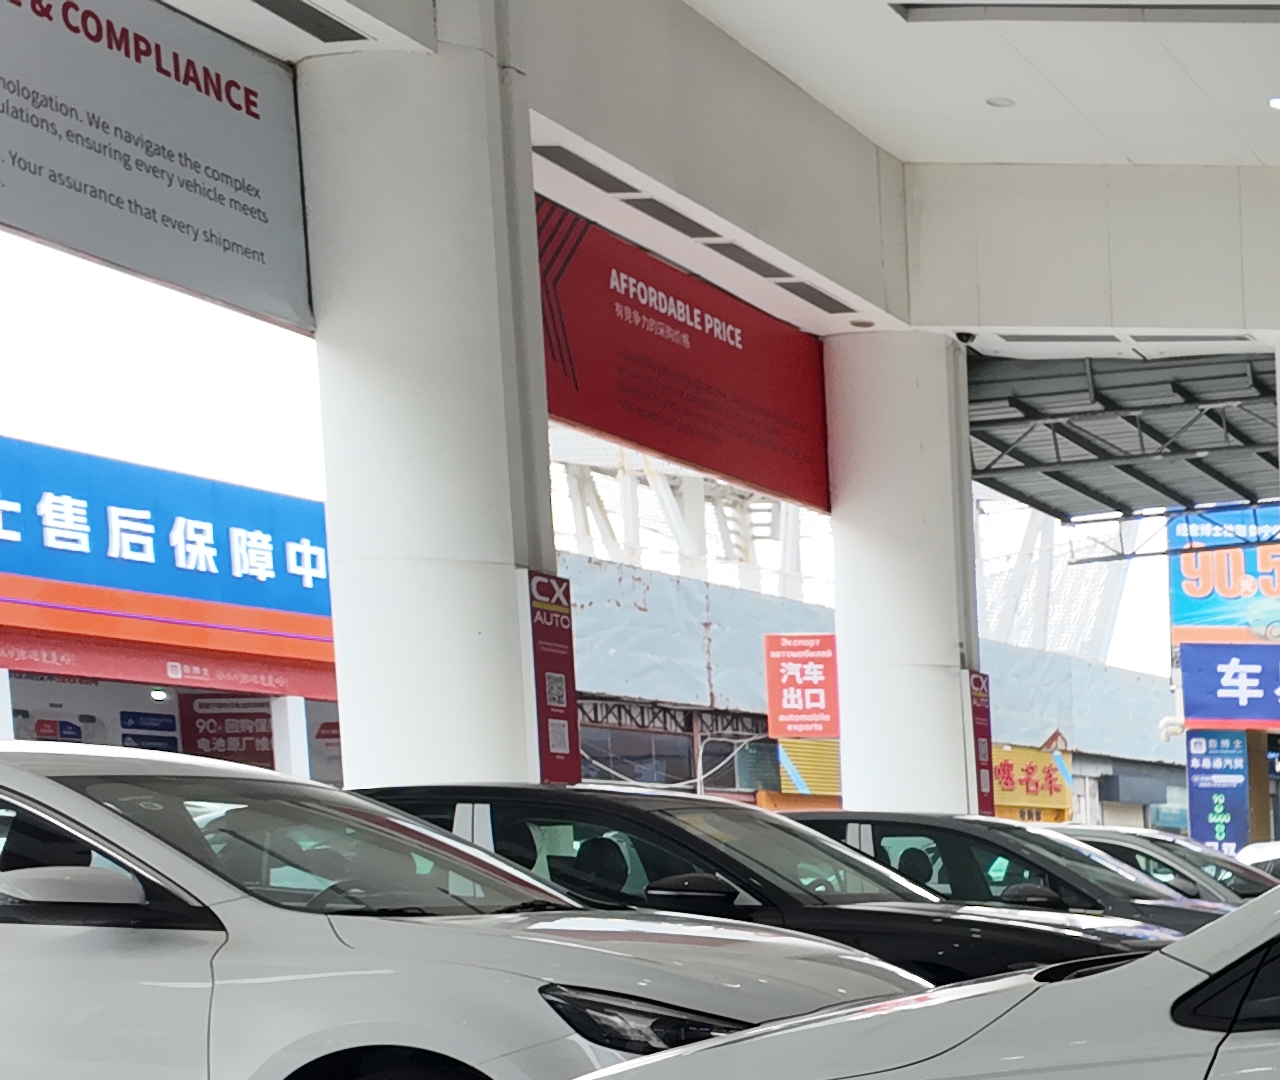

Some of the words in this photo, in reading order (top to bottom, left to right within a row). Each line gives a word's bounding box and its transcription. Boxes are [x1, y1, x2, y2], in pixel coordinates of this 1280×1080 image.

[61, 1, 260, 120] COMPLIANCE
[65, 129, 132, 171] ensuring
[135, 158, 174, 188] every
[177, 175, 225, 206] vehicle
[229, 198, 269, 223] meets
[86, 111, 110, 135] We
[113, 125, 175, 162] navigate
[178, 151, 201, 174] the
[204, 165, 261, 199] complex
[8, 149, 44, 177] Your
[48, 169, 125, 209] assurance
[128, 199, 158, 223] that
[161, 214, 199, 242] every
[202, 228, 266, 265] shipment
[609, 268, 702, 331] AFFORDABLE
[704, 313, 743, 350] PRICE
[531, 575, 569, 607] CX
[533, 610, 571, 630] AUTO
[779, 661, 825, 685] 汽车
[782, 686, 825, 710] 出口
[970, 674, 988, 693] CX
